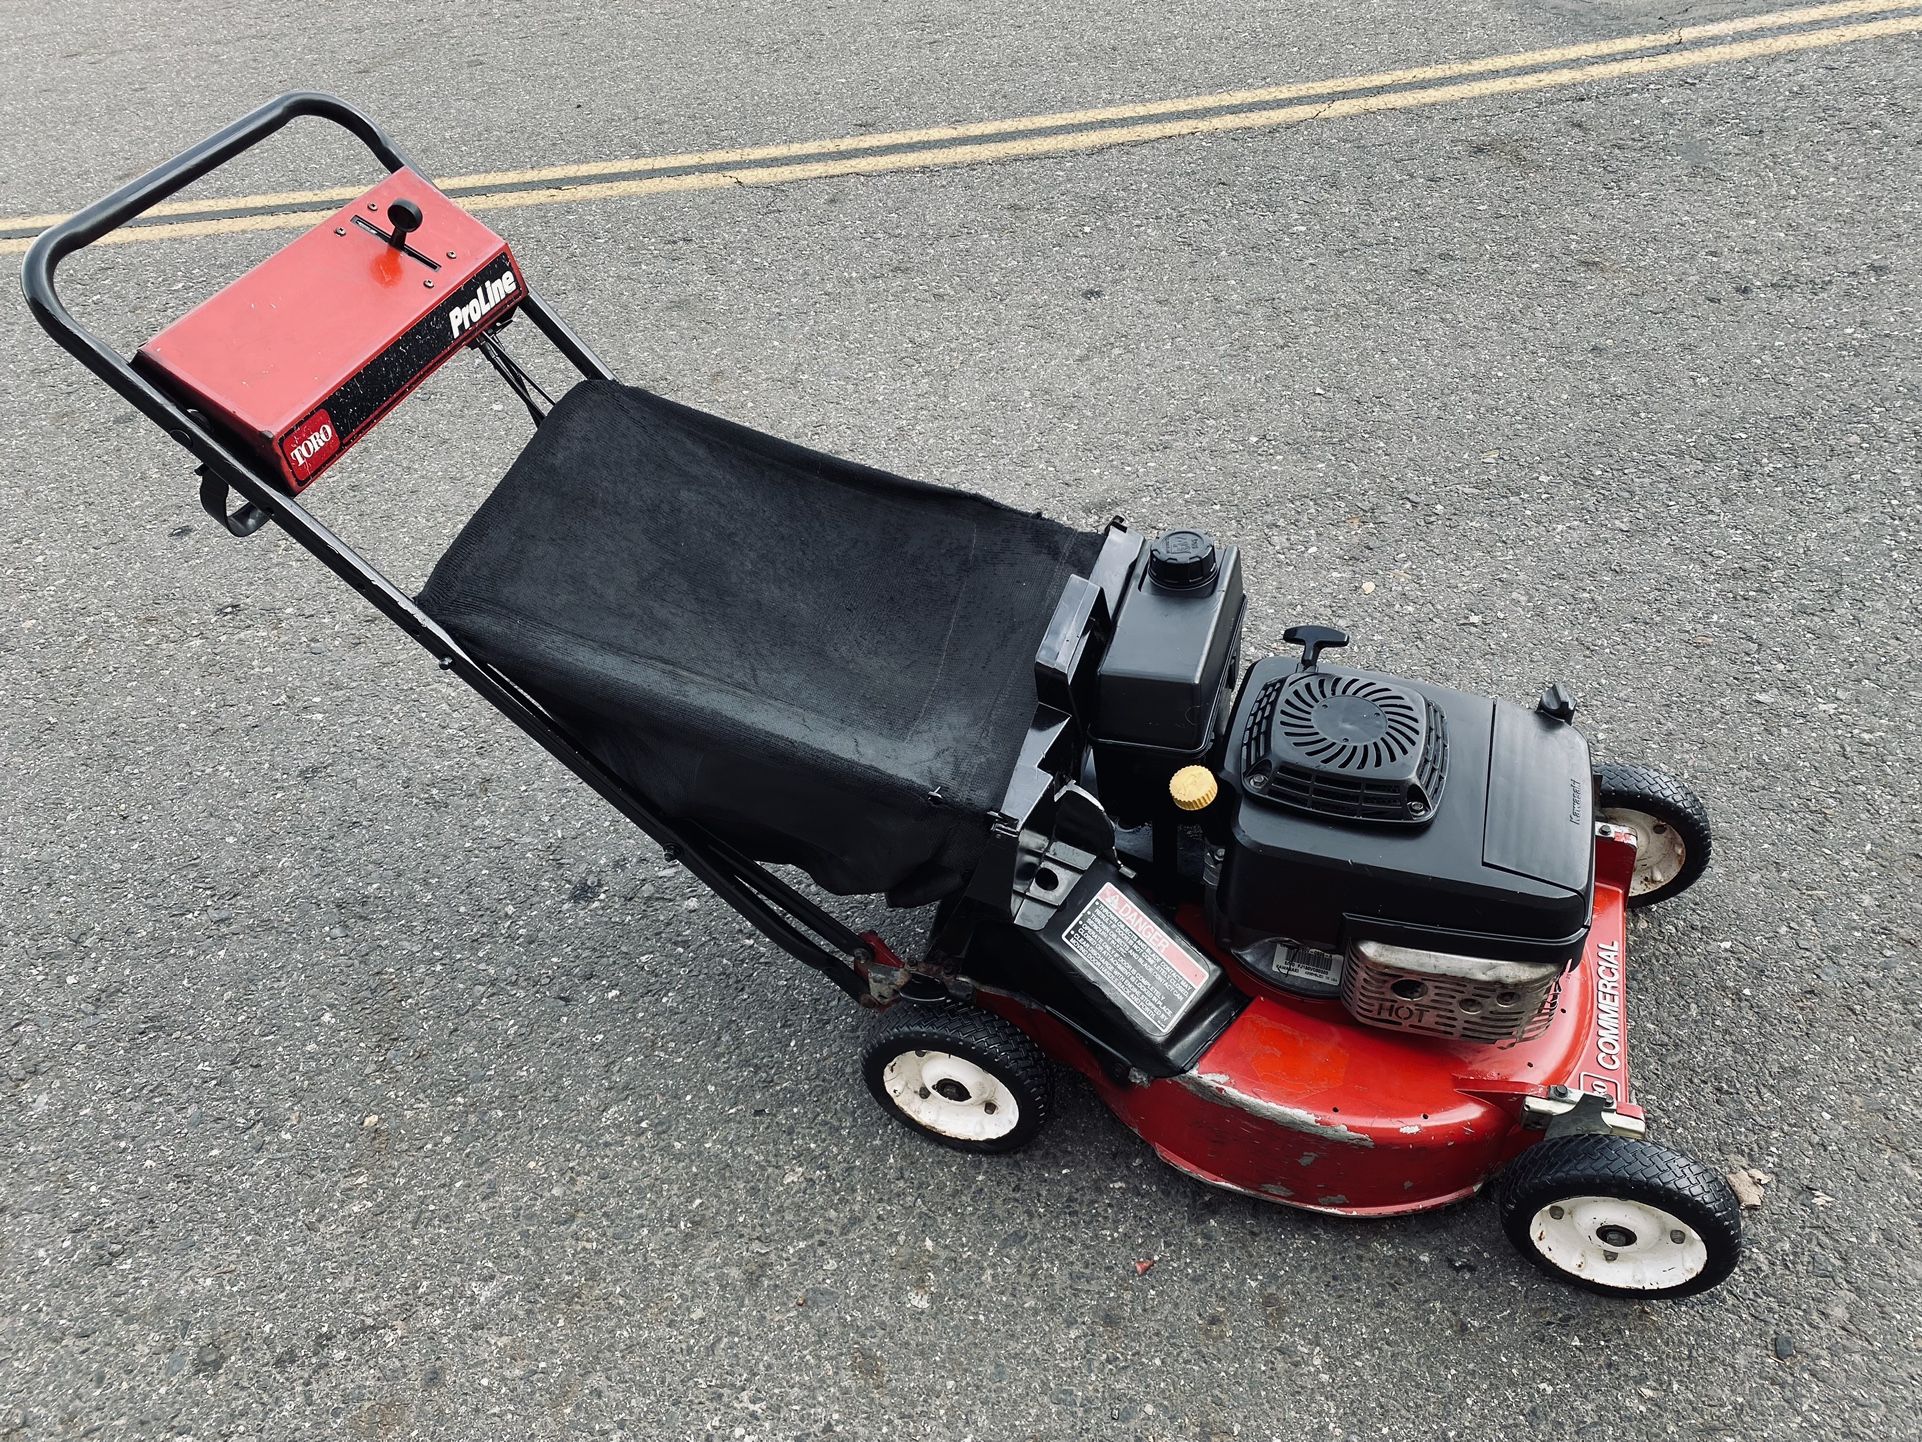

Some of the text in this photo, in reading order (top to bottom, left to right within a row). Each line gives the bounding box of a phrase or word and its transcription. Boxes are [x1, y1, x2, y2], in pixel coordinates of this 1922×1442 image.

[449, 270, 517, 339] ProLine
[290, 424, 333, 466] TORO
[1570, 778, 1581, 825] Kawasaki
[1081, 922, 1103, 944] OPERATE
[1101, 940, 1116, 955] ONLY
[1113, 951, 1120, 959] IF
[1117, 955, 1133, 971] DOOR
[1134, 971, 1166, 1002] COMPLETELY
[1089, 912, 1184, 1001] THROWN OBJECTS AND BLADE CONTACT CAN
[1093, 907, 1113, 926] RESULT
[1114, 927, 1130, 942] DOOR
[1131, 942, 1143, 954] NOT
[1097, 903, 1192, 991] THROWN OBJECTS AND BLADE CONTACT MAY
[1118, 902, 1170, 953] DANGER
[1069, 936, 1088, 956] MOVING
[1085, 952, 1101, 968] DOOR
[1098, 964, 1119, 984] HANDLE
[1116, 980, 1131, 996] BACK
[1129, 992, 1141, 1005] AND
[1072, 932, 1169, 1022] CLEAR DISCHARGE WITH ENGINE STOPPED BY
[1077, 927, 1097, 946] CLOSED
[1094, 942, 1104, 953] OR
[1101, 949, 1132, 978] ATTACHMENT
[1133, 979, 1154, 999] LOCKED
[1151, 995, 1158, 1003] IN
[1377, 1003, 1430, 1023] HOT
[1597, 940, 1620, 1071] COMMERCIAL
